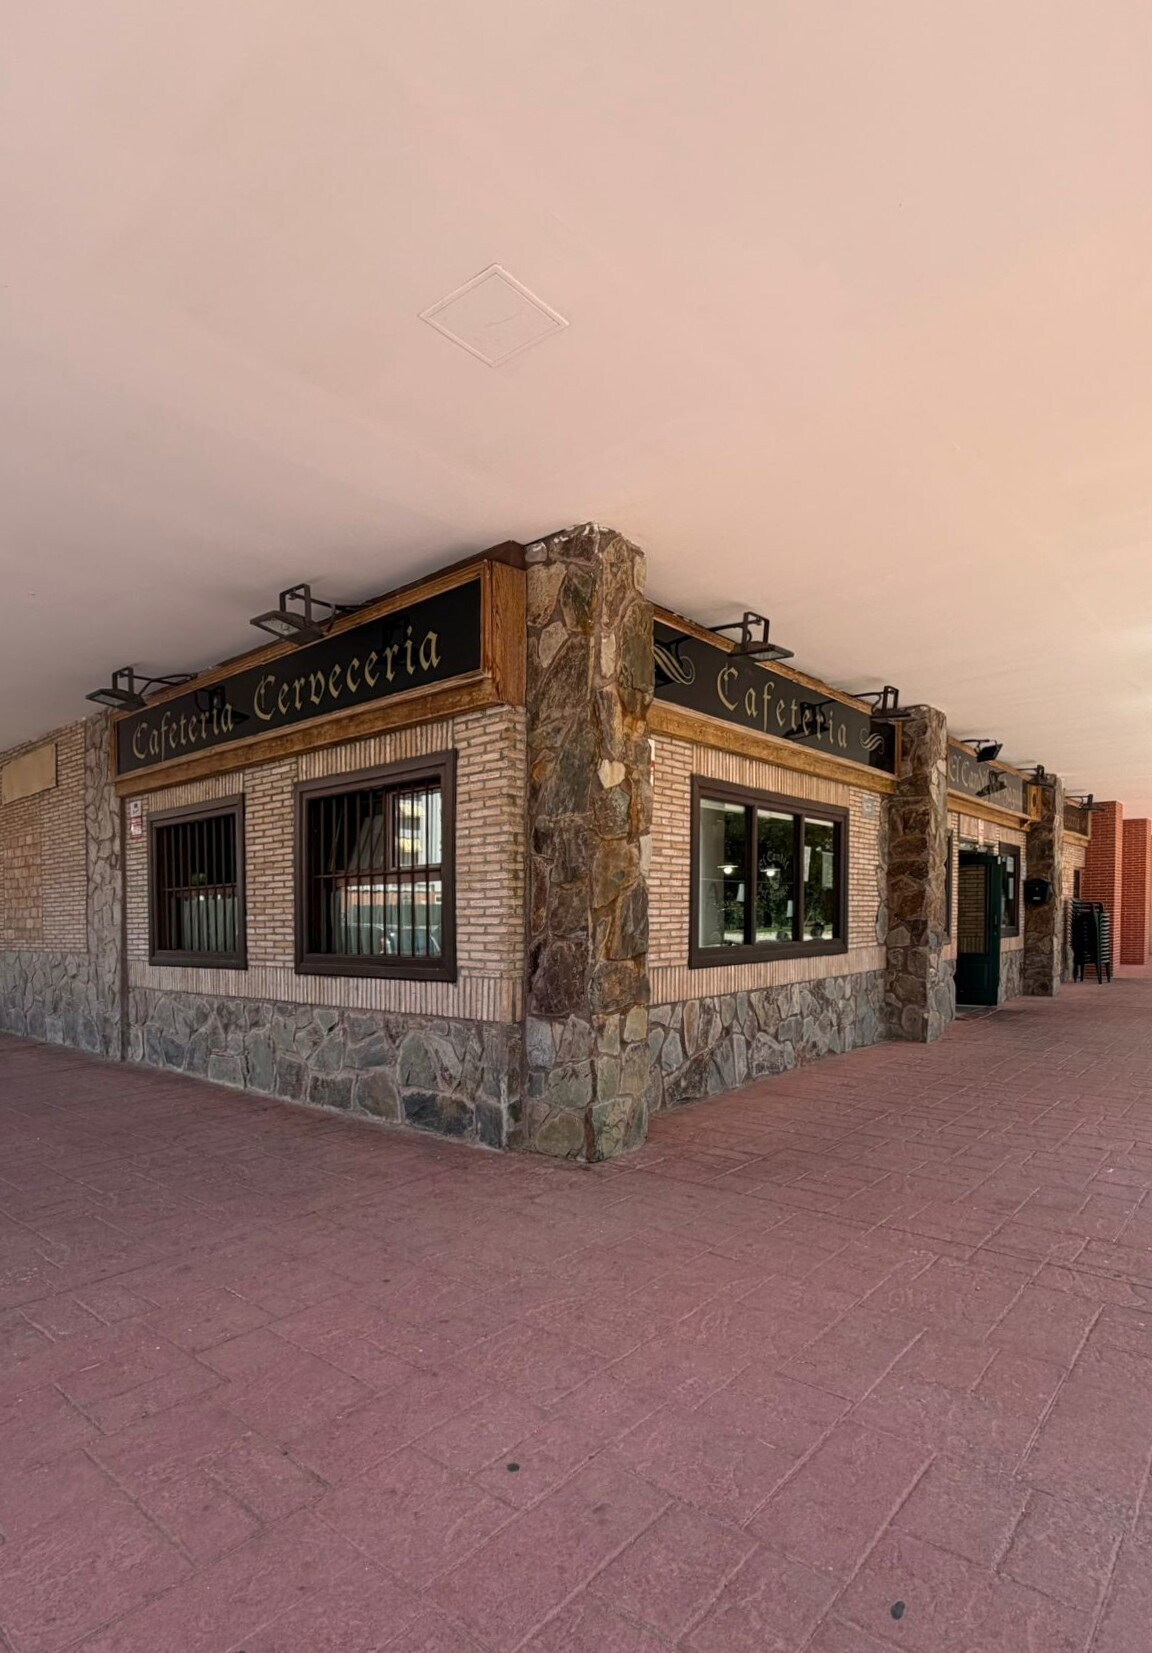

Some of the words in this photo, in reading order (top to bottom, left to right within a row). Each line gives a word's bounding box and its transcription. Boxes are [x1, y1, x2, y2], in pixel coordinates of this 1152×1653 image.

[132, 697, 235, 760] Cafeteria
[253, 626, 441, 720] Cerveceria
[717, 663, 847, 748] Cafeteria
